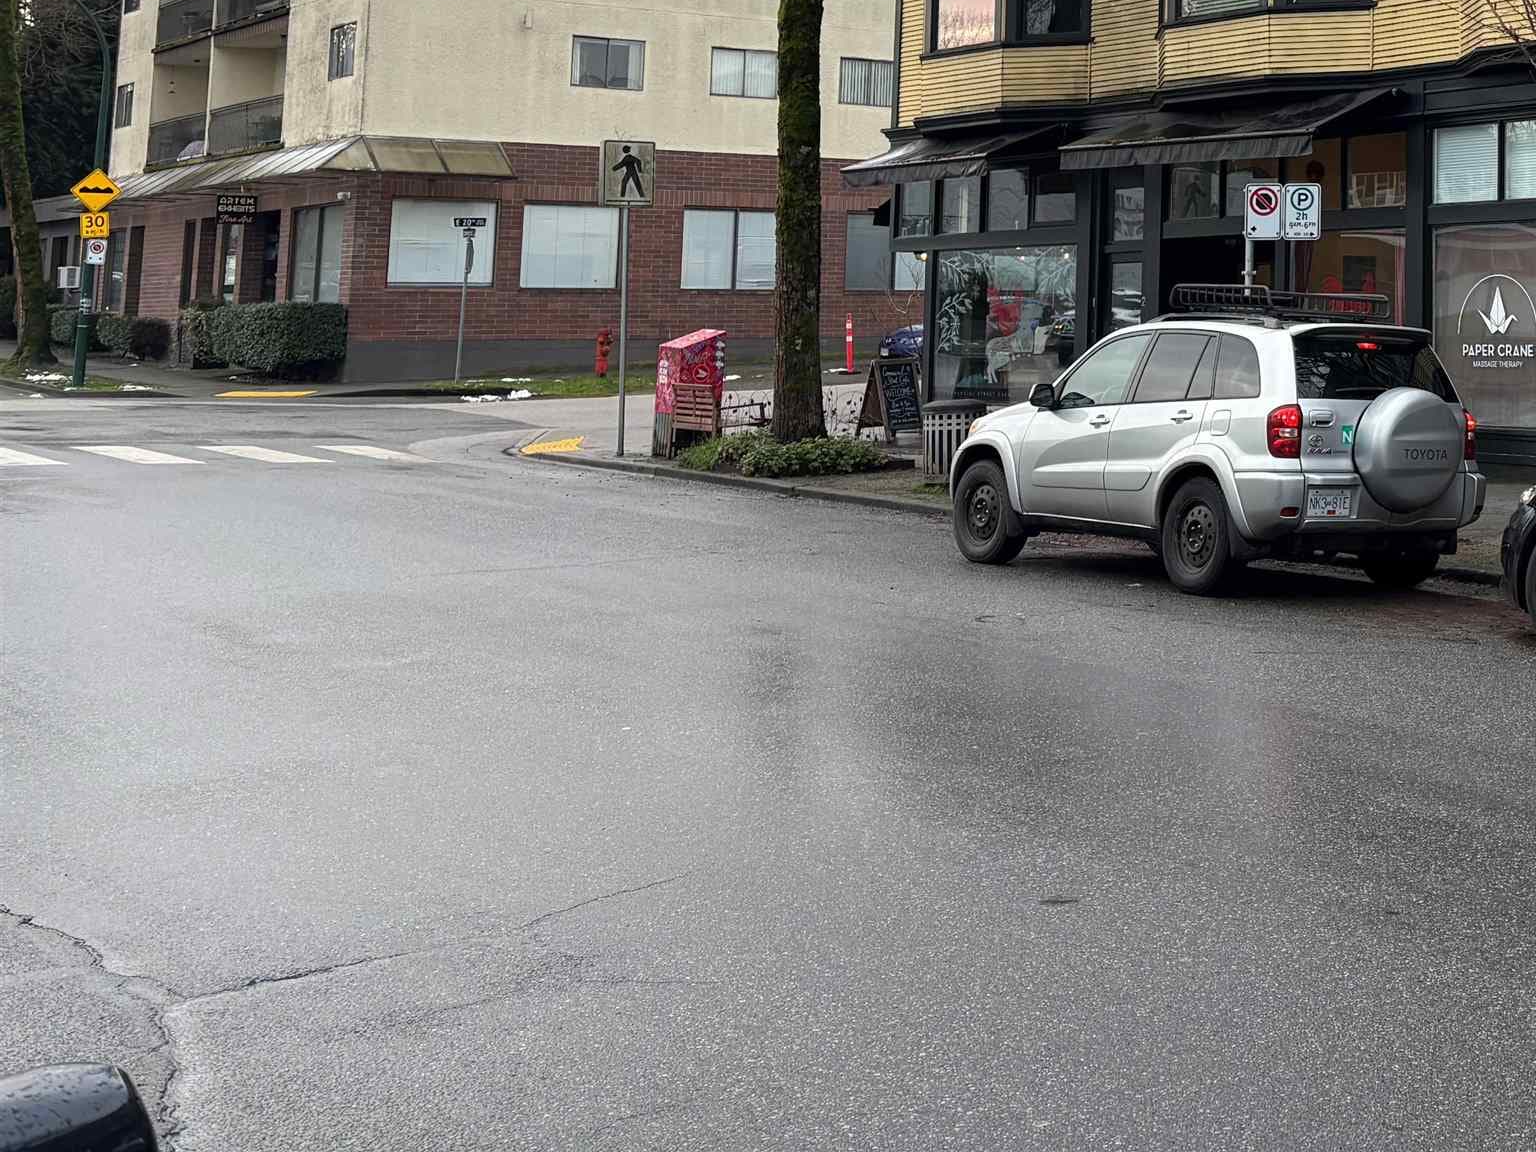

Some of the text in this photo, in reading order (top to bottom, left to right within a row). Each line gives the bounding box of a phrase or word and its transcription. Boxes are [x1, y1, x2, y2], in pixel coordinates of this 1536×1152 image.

[84, 215, 105, 228] 30
[1295, 212, 1308, 221] 2h
[1462, 343, 1534, 357] PAPER CRANE
[1472, 360, 1523, 368] MASSAGE THERAPY
[1342, 431, 1353, 444] N
[1404, 448, 1448, 461] TOYOTA
